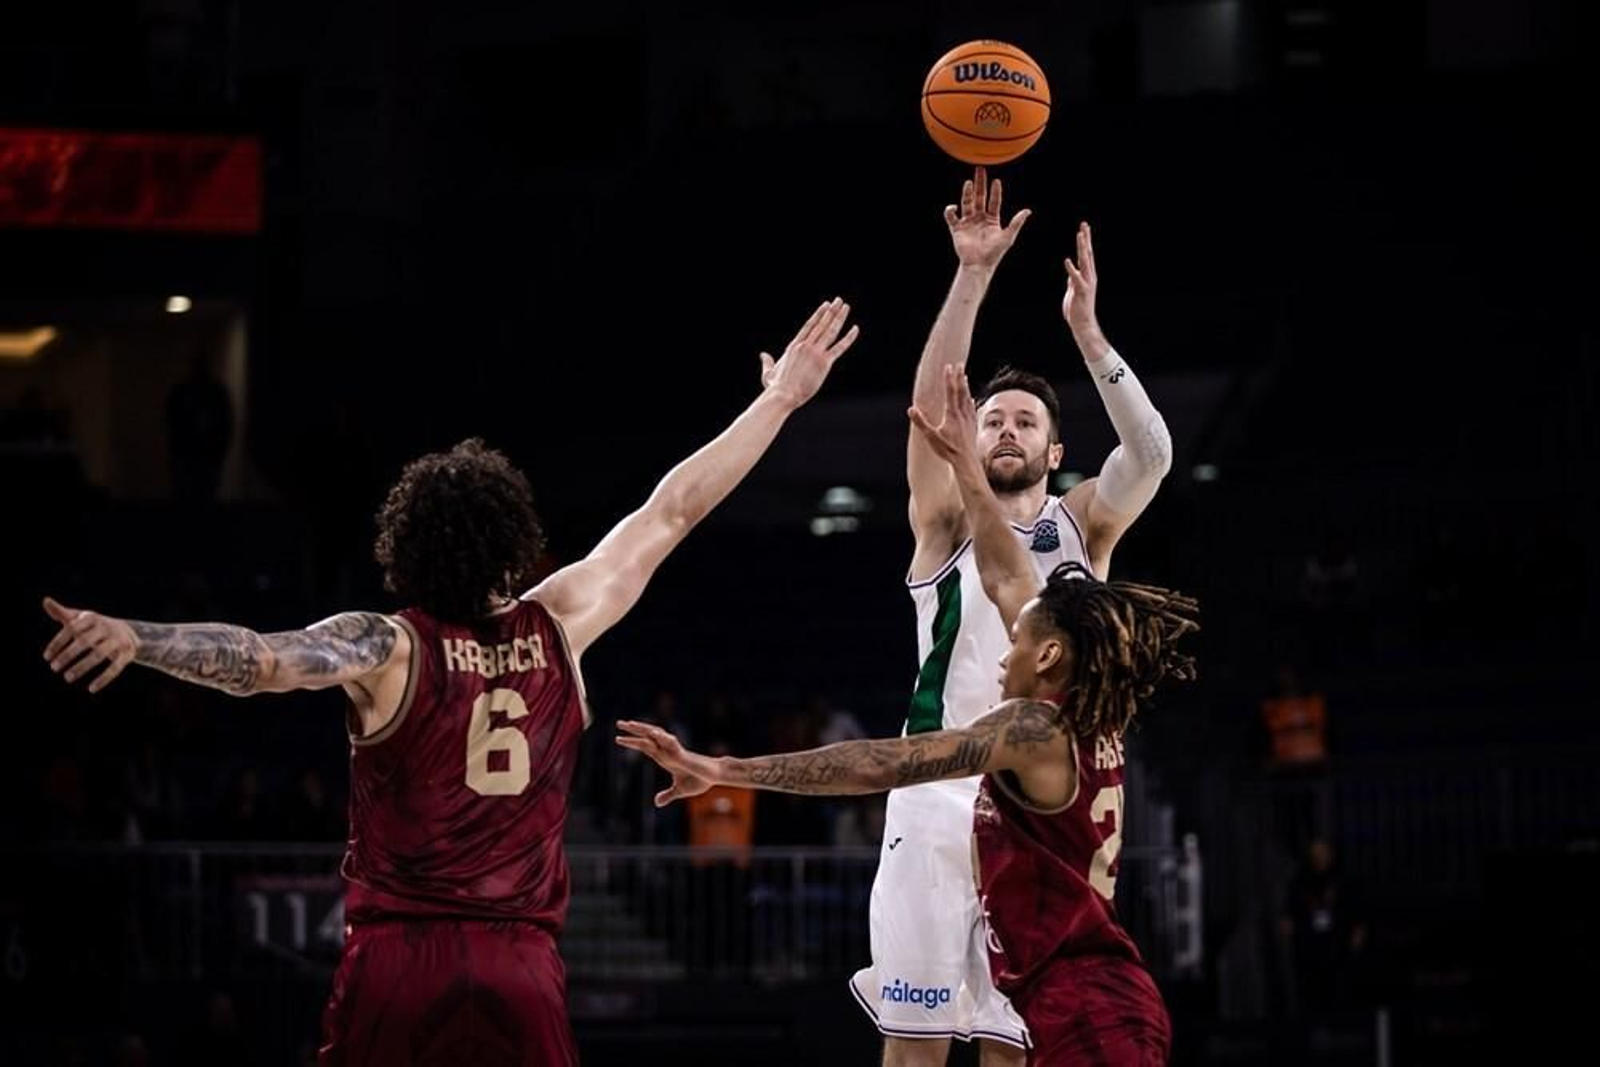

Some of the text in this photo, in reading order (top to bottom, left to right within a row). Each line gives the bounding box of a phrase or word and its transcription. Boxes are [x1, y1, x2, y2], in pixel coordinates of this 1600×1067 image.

[953, 61, 1036, 91] Wilson
[465, 688, 531, 796] 6
[1088, 784, 1124, 900] 2
